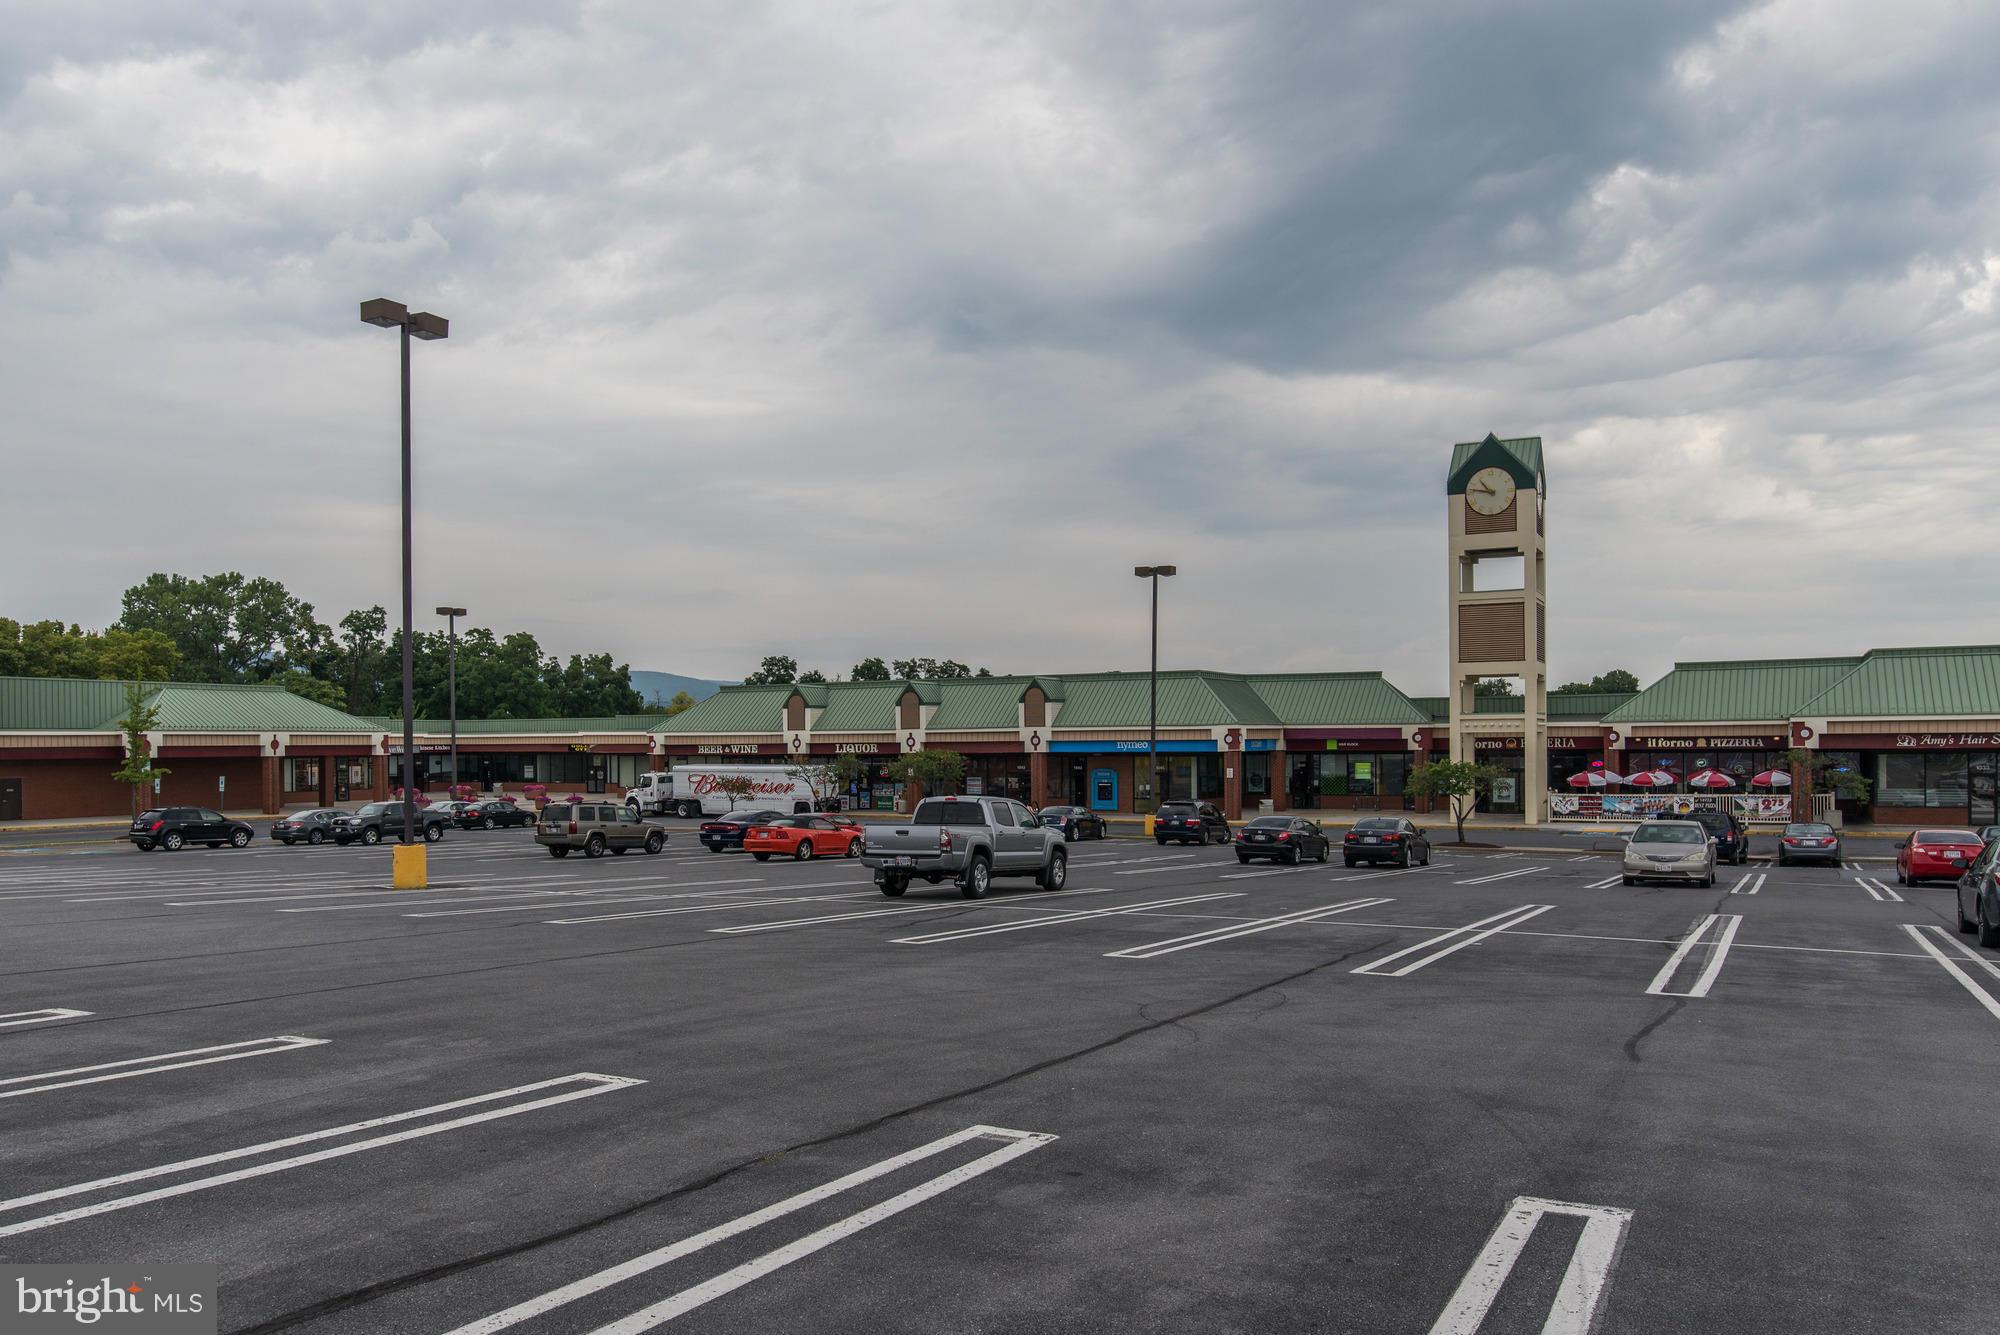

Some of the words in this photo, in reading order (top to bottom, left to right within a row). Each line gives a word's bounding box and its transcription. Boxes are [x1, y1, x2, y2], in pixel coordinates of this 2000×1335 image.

[1475, 740, 1503, 749] orno
[1658, 738, 1694, 748] forno
[1710, 738, 1765, 748] PIZZERIA
[1920, 734, 1955, 747] Amy's
[1959, 734, 1988, 745] Hair
[698, 745, 723, 754] BEER
[731, 744, 758, 754] WINE
[835, 743, 880, 753] LIQUOR
[1117, 741, 1149, 751] nymeo
[688, 773, 796, 795] Bueiser
